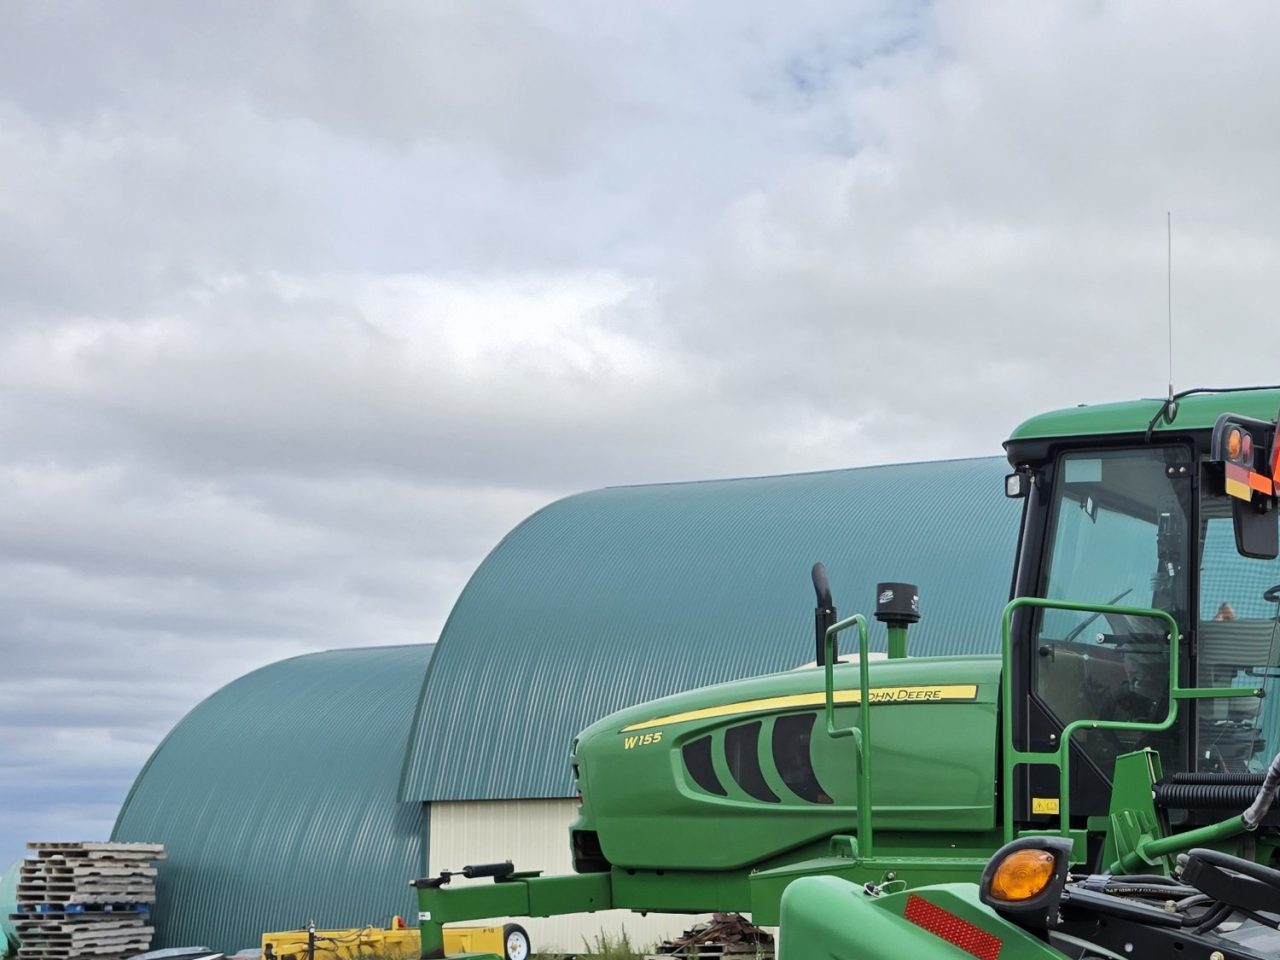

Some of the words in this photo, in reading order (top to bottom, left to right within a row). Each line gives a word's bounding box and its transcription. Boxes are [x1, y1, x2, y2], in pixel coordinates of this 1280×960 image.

[858, 692, 895, 702] OHN
[896, 689, 942, 700] DEERE
[624, 731, 663, 750] W155
